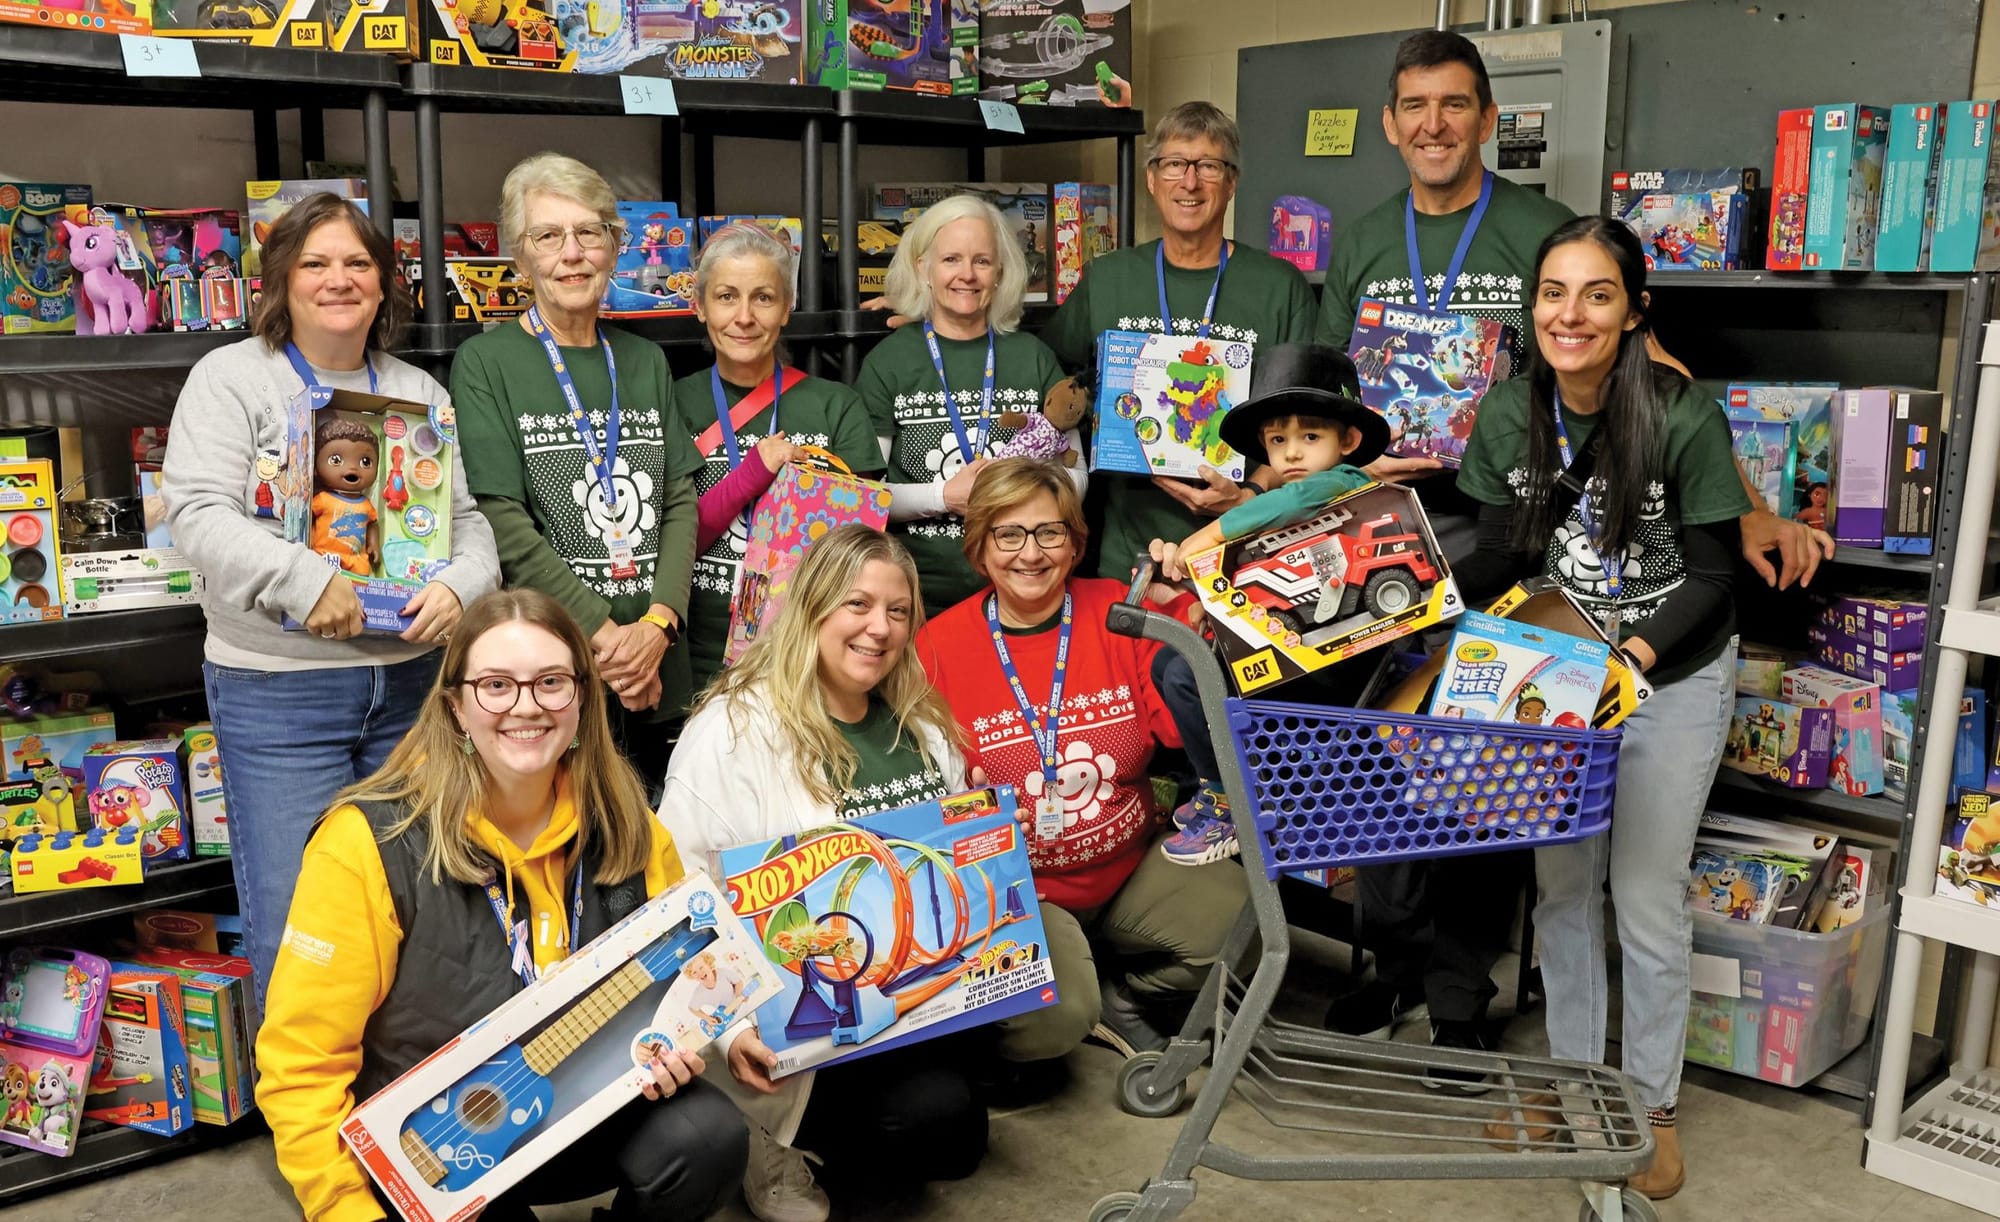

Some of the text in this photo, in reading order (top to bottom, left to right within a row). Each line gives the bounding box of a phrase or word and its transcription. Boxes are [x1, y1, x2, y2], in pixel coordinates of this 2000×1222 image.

[297, 28, 317, 40] CAT
[372, 24, 398, 40] CAT
[140, 44, 163, 62] 3+
[436, 46, 454, 60] CAT
[675, 45, 757, 66] MONSTER
[631, 84, 653, 104] 3+
[1313, 112, 1347, 127] Puzzles
[1313, 131, 1340, 142] Games
[1634, 171, 1664, 181] STAR
[1630, 178, 1664, 190] WARS
[25, 193, 62, 206] DORY
[859, 275, 886, 285] TANLE
[1478, 291, 1521, 302] LOVE
[1361, 308, 1380, 319] LEGO
[1109, 344, 1138, 354] DINO BOT
[1108, 355, 1167, 368] ROBOT DINOSAURE
[1731, 394, 1747, 402] LEGO
[894, 407, 932, 419] HOPE
[1001, 403, 1039, 414] LOVE
[523, 432, 568, 446] HOPE
[1393, 543, 1406, 553] CAT
[74, 557, 118, 568] Calm Down
[1286, 551, 1307, 565] 84
[86, 565, 109, 574] Bottle
[694, 563, 714, 575] OPE
[1349, 618, 1396, 641] POWER HAULERS
[1465, 618, 1507, 635] scintillant
[1575, 641, 1603, 655] Glitter
[1242, 659, 1271, 682] CAT
[1455, 667, 1503, 681] MESS
[1570, 668, 1591, 680] Disney
[1451, 680, 1501, 694] FREE
[1794, 679, 1819, 699] Disney
[978, 701, 1136, 745] HOPE OY LOVE
[136, 763, 172, 780] Potato
[148, 775, 172, 790] Head
[0, 788, 39, 801] URTLES
[1963, 803, 1987, 812] JEDI
[1073, 833, 1101, 851] JOY
[1118, 800, 1143, 829] LOVE
[968, 961, 1044, 994] CORKSCREW TWIST KIT
[964, 974, 1049, 1011] KIT DE GIROS SEM LIMITE
[966, 993, 977, 1003] KIT
[979, 989, 988, 998] DE
[988, 982, 1010, 995] GIROS
[1010, 978, 1022, 987] SIN
[121, 1026, 146, 1035] INCLUDES
[121, 1037, 143, 1045] VEHICLE
[113, 1048, 139, 1058] THROUGH
[387, 1180, 410, 1210] Ukulele
